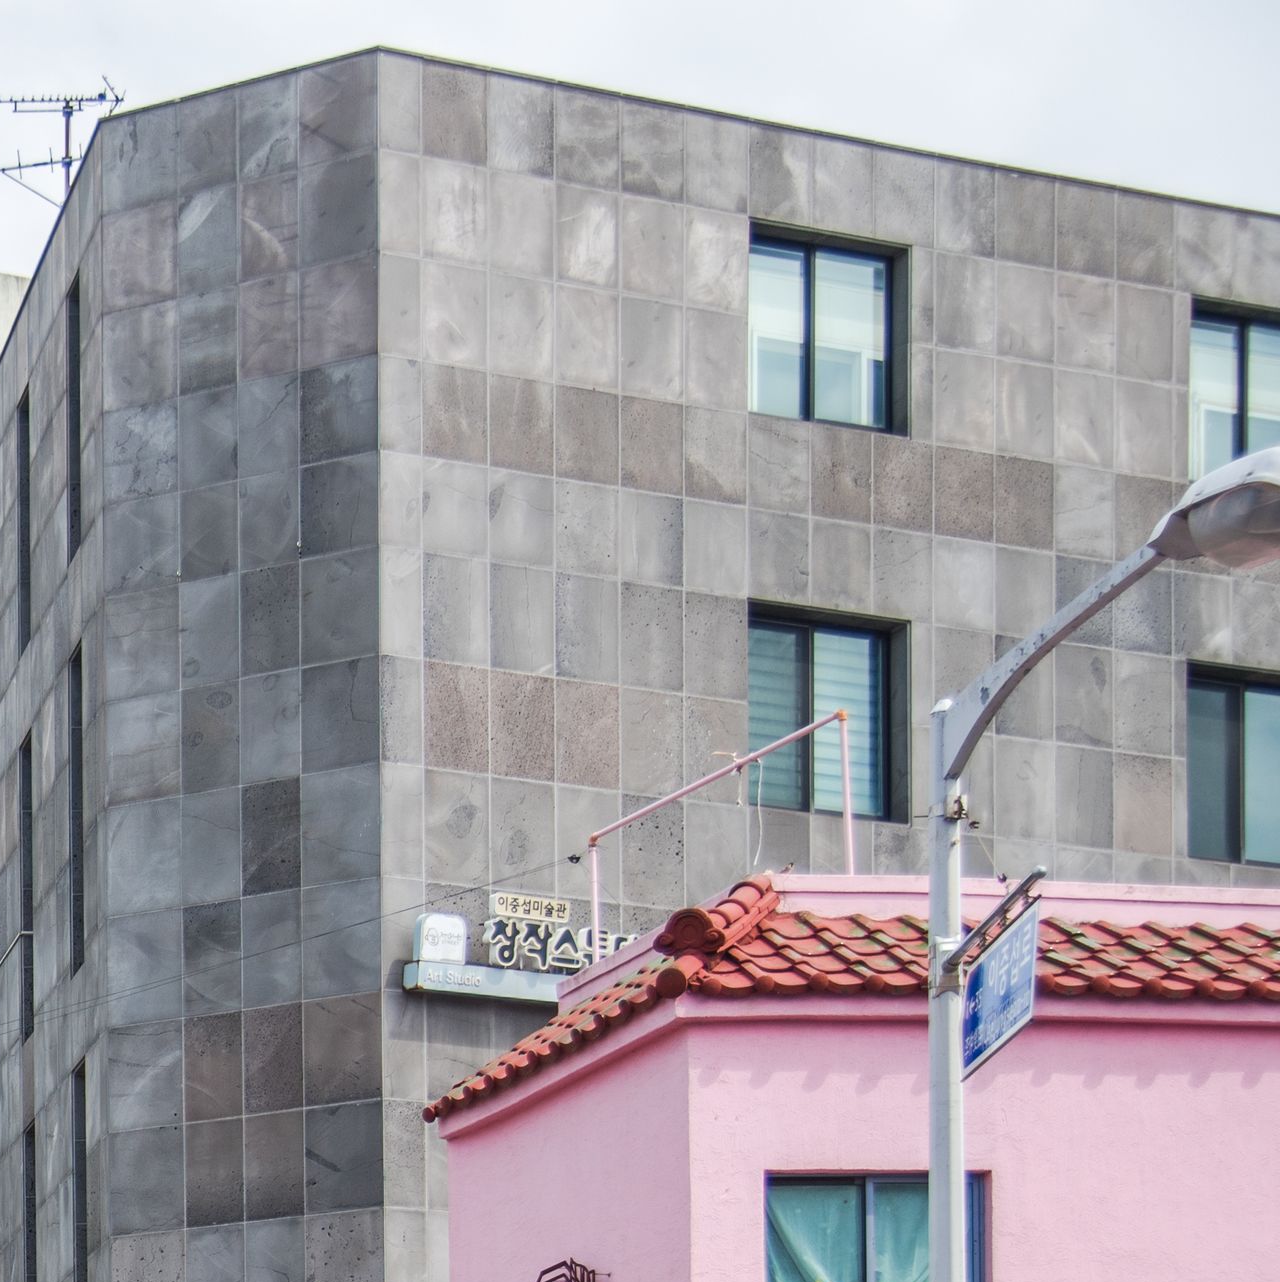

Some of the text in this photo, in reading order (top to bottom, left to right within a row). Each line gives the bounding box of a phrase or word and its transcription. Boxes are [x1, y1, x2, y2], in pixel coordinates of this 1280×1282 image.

[497, 896, 568, 919] 이중섭미술관
[988, 922, 1032, 996] 이중섭로
[425, 970, 482, 988] Art Studio
